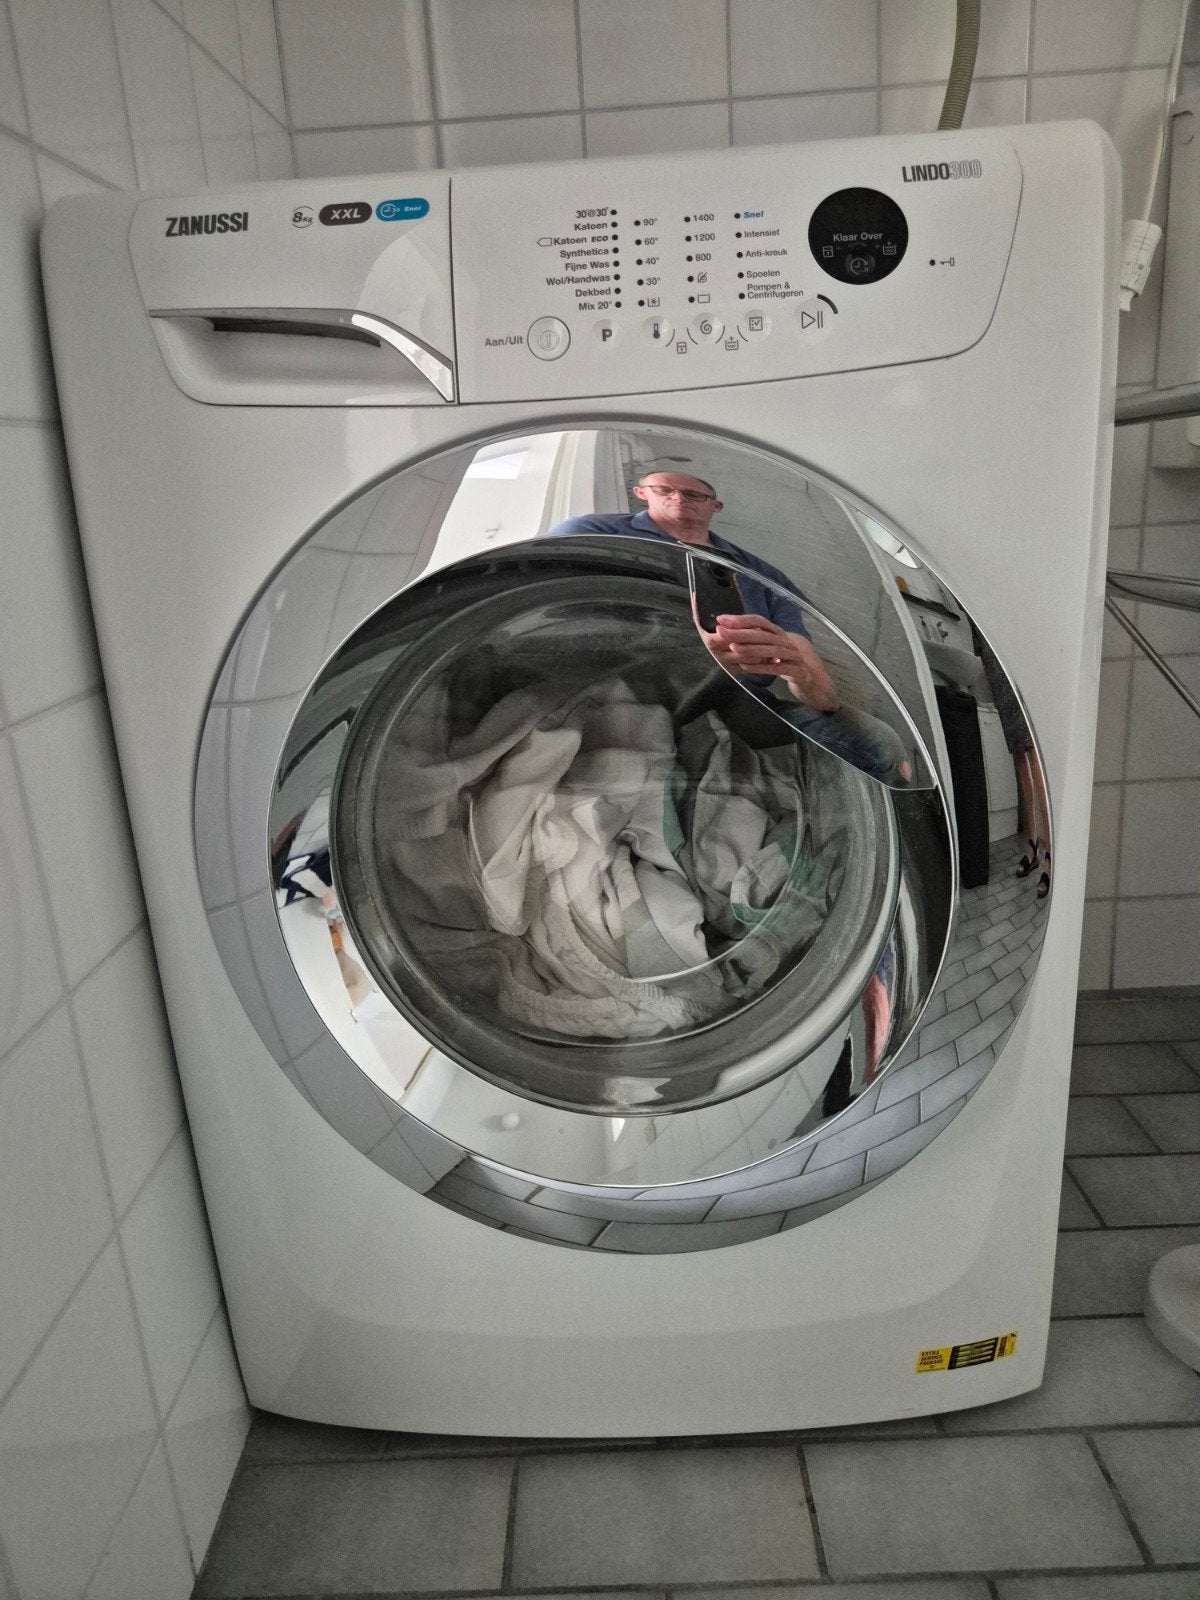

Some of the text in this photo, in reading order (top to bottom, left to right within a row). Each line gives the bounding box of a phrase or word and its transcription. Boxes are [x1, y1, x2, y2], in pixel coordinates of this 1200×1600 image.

[902, 159, 982, 182] LINDO300
[330, 208, 362, 220] XXL
[693, 213, 715, 222] 1400
[743, 210, 764, 219] Snel
[165, 211, 249, 238] ZANUSSI
[574, 222, 608, 231] Katoen
[643, 217, 658, 226] 90°
[694, 233, 716, 242] 1200
[744, 228, 780, 238] Intensief
[833, 232, 883, 242] Klaar Over
[553, 236, 587, 245] Katoen
[644, 237, 659, 246] 60°
[560, 247, 609, 259] Synthetica
[695, 253, 712, 262] 800
[745, 248, 788, 258] Anti-kreuk
[645, 257, 660, 265] 40°
[564, 261, 610, 272] Fijne Was
[746, 270, 780, 279] Spoelen
[545, 274, 611, 286] Wol/Handwas
[646, 277, 661, 286] 30°
[747, 281, 790, 291] Pompen &
[575, 287, 611, 297] Dekbed
[747, 290, 804, 299] Centrifugeren
[578, 300, 612, 311] Mix 20°
[602, 328, 613, 342] P
[484, 335, 523, 347] Aan/Uit
